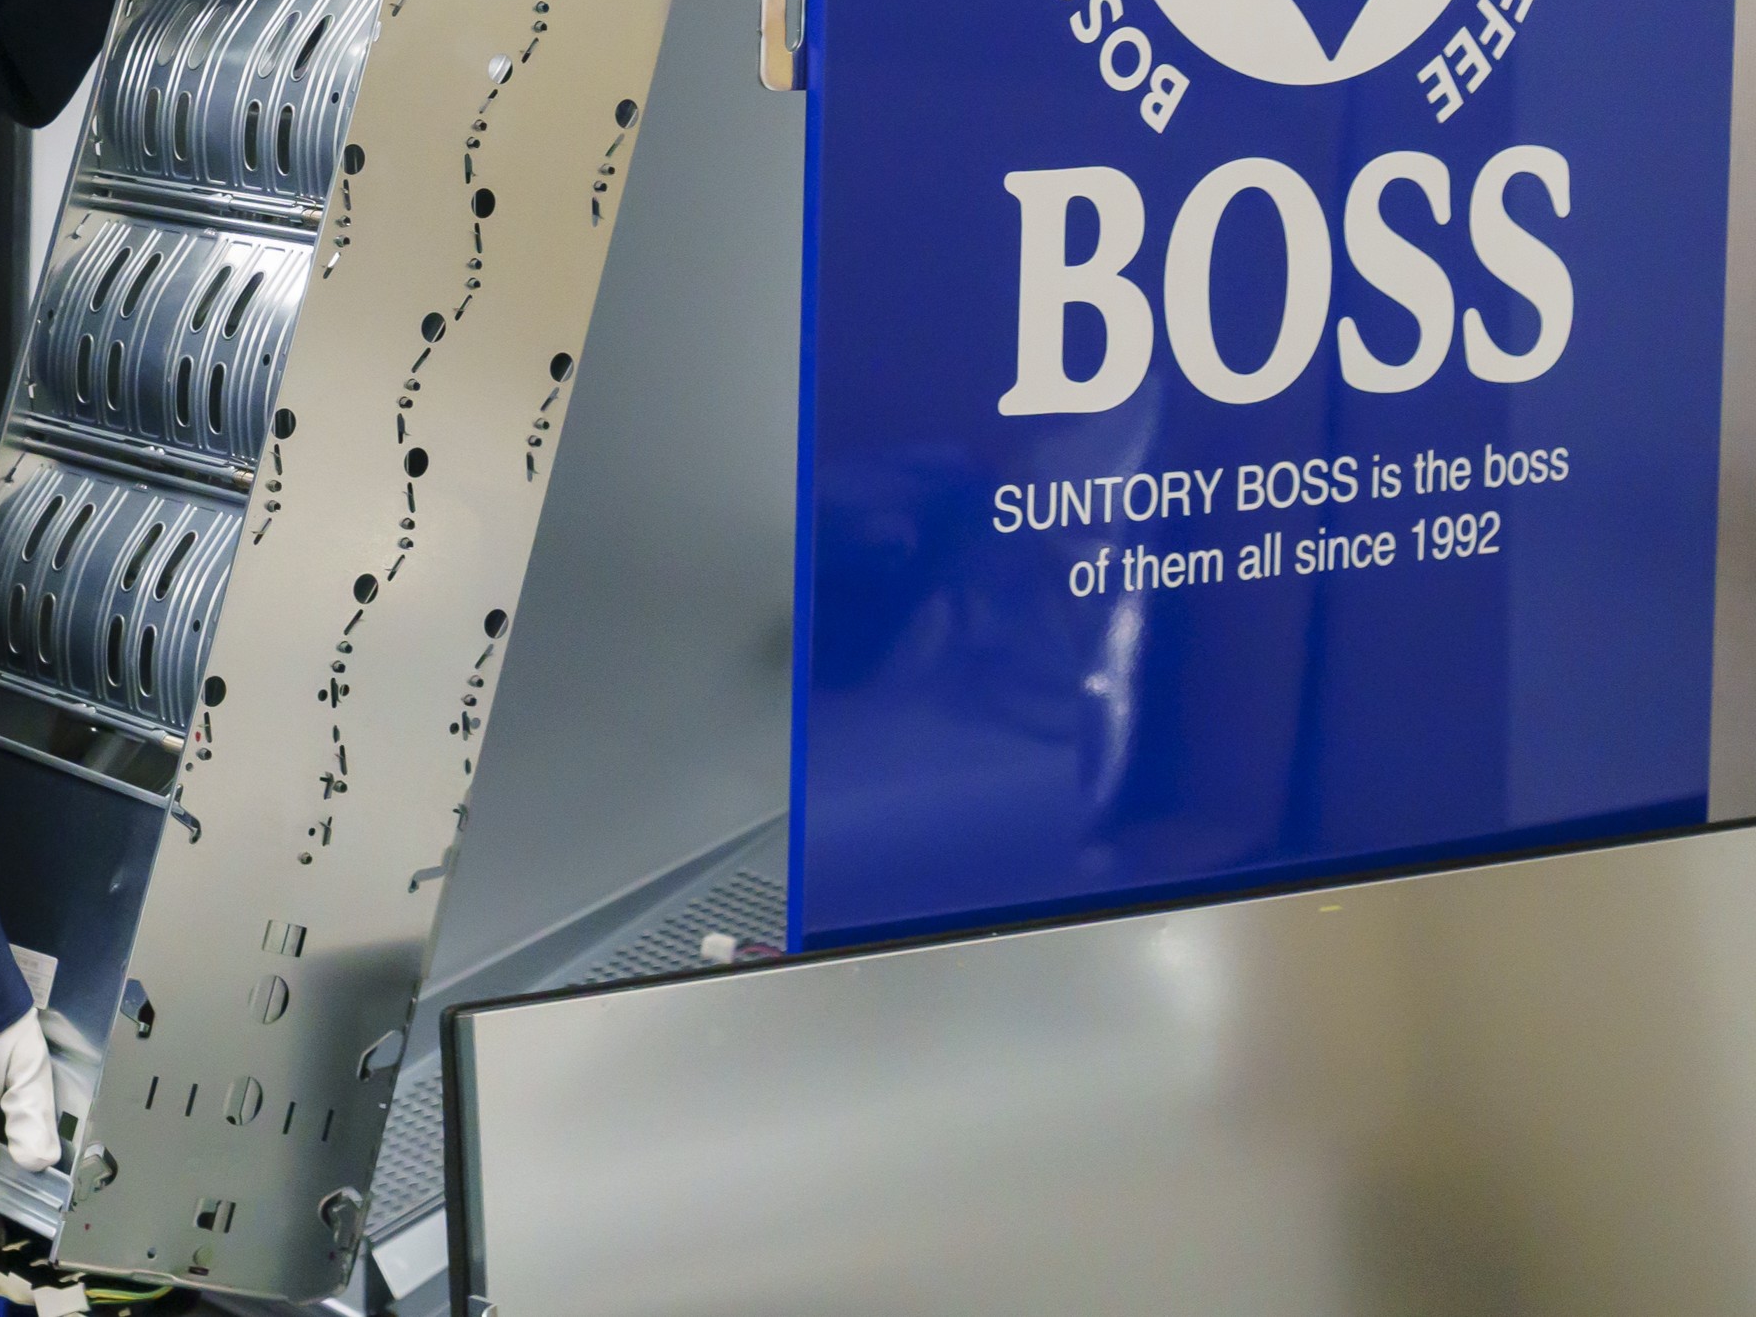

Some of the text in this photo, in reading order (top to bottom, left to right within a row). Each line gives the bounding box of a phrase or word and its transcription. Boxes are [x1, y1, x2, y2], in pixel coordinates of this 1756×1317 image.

[997, 144, 1574, 417] BOSS
[993, 444, 1569, 533] SUNTORY BOSS is the boss
[1069, 510, 1501, 597] of them all since 1992
